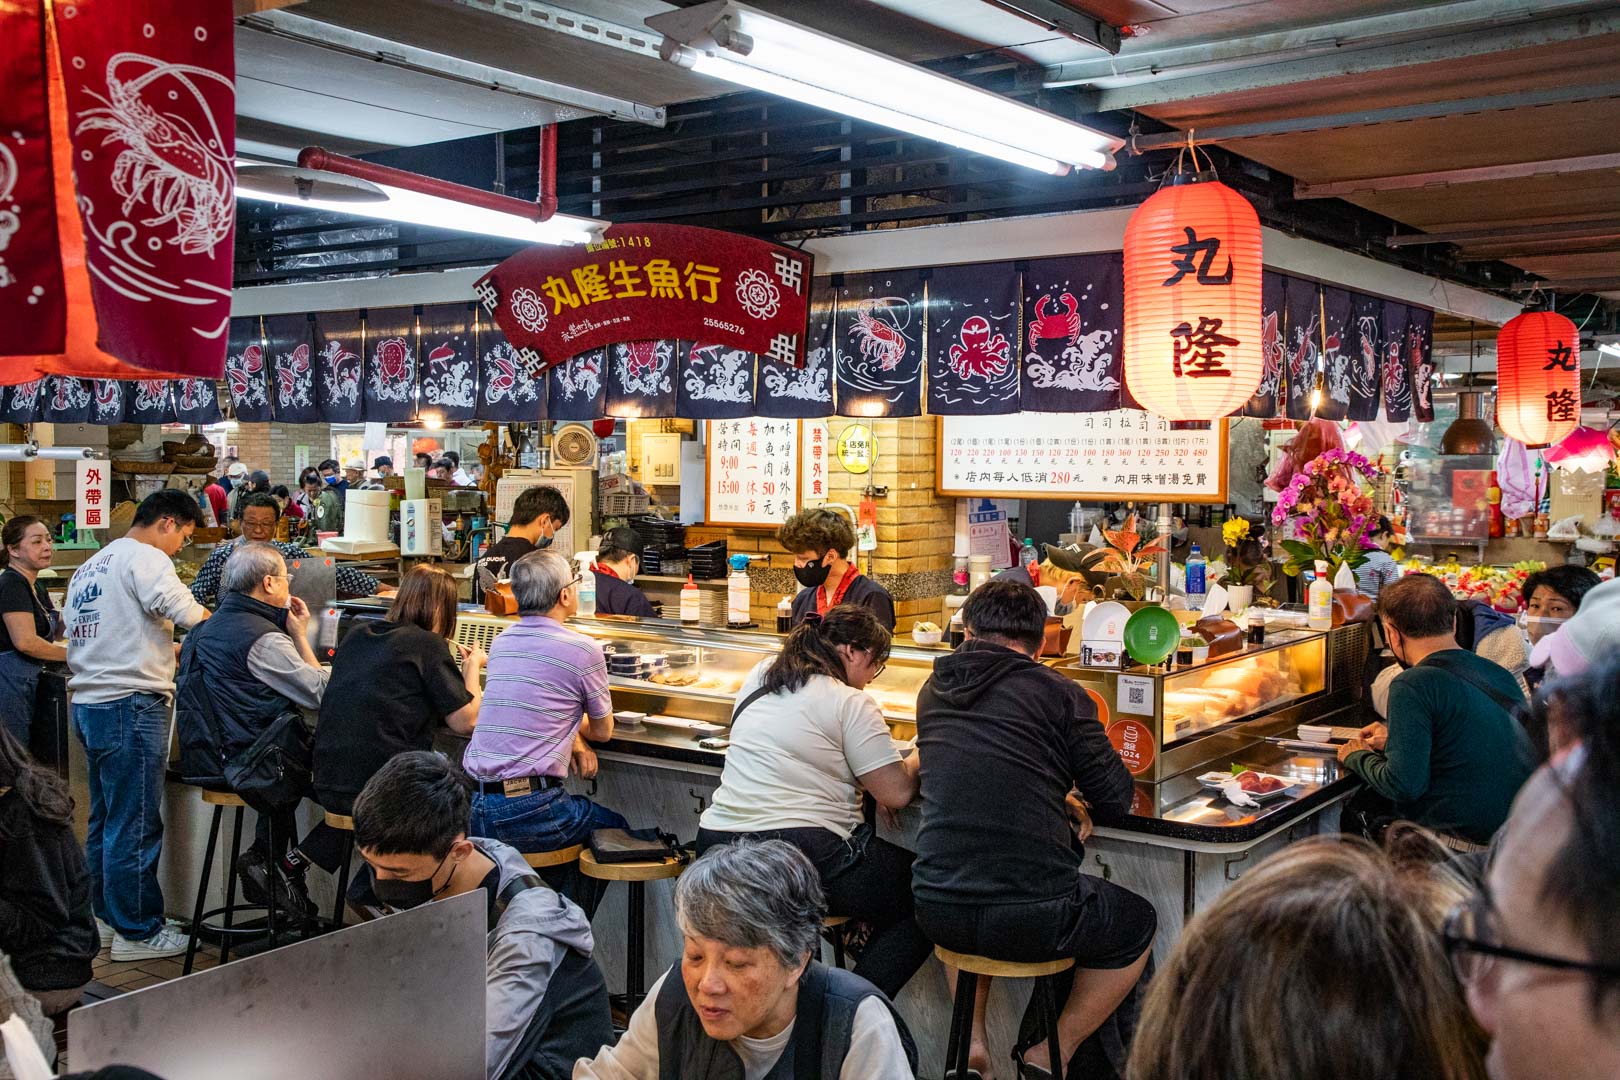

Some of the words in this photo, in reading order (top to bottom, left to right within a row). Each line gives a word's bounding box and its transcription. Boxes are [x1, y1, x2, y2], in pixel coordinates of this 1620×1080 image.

[541, 259, 721, 315] 丸隆生魚行
[1162, 226, 1241, 378] 丸隆
[703, 317, 745, 335] 25565276
[1543, 340, 1578, 423] 丸隆
[718, 422, 740, 435] 營業
[718, 439, 741, 452] 時間
[1066, 448, 1079, 456] 220
[1083, 448, 1096, 456] 100
[1138, 448, 1151, 456] 120
[1155, 448, 1169, 456] 250
[1174, 448, 1188, 456] 320
[1193, 448, 1208, 456] 480
[721, 456, 738, 469] 9:00
[813, 428, 823, 495] 禁帶外食
[718, 481, 739, 494] 15:00
[86, 468, 102, 526] 外帶區
[78, 612, 101, 624] EXPLORE
[71, 622, 100, 638] MEET
